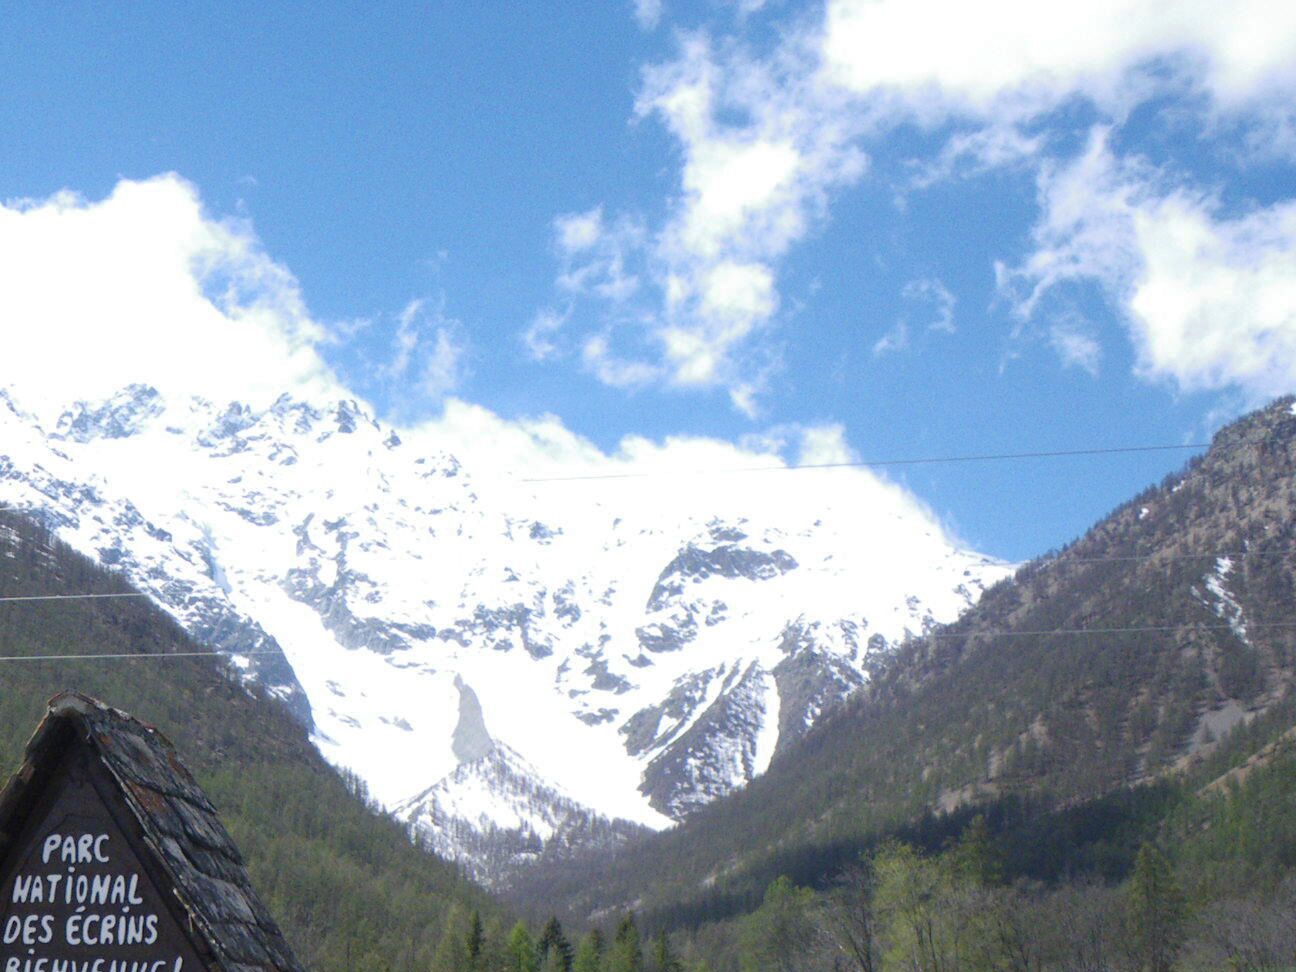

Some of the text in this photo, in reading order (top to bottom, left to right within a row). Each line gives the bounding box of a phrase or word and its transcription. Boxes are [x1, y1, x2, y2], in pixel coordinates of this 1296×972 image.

[42, 833, 110, 864] PARC
[12, 866, 143, 905] NATIONAL
[3, 905, 159, 946] DES ÉCRINS
